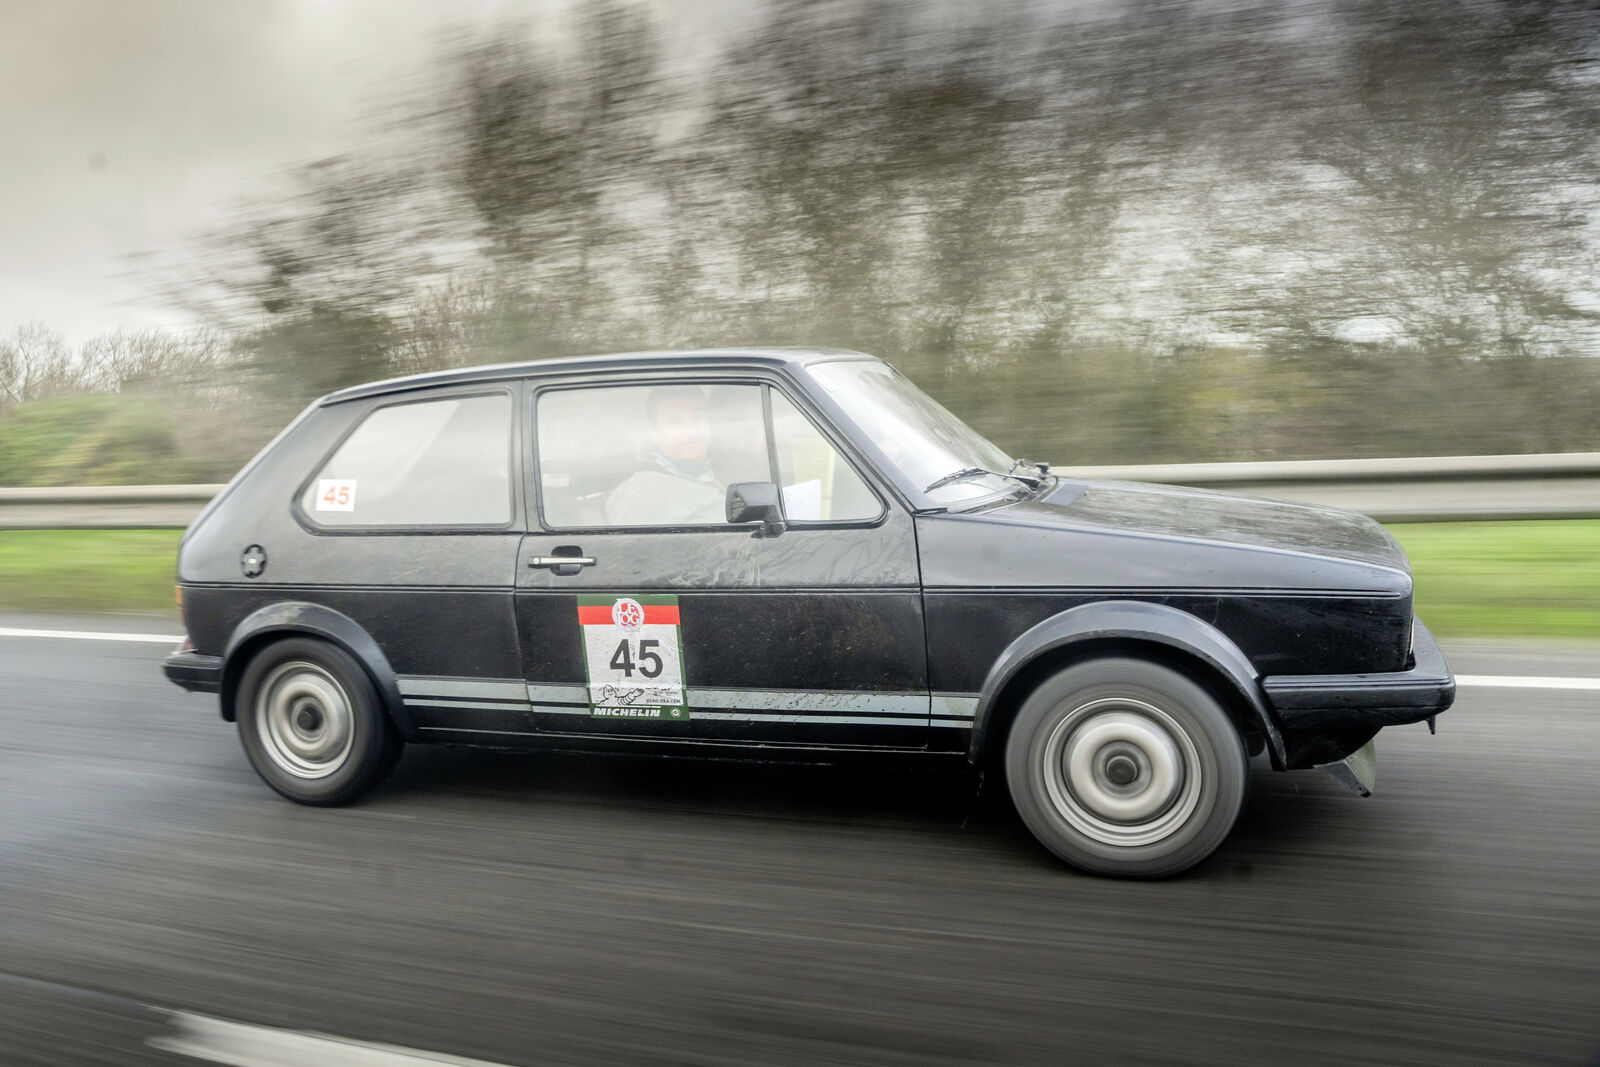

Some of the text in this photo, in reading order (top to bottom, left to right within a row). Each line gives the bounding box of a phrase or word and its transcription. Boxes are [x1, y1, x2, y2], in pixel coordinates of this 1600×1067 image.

[324, 486, 350, 505] 45
[610, 639, 663, 678] 45
[593, 707, 661, 717] MICHELIN
